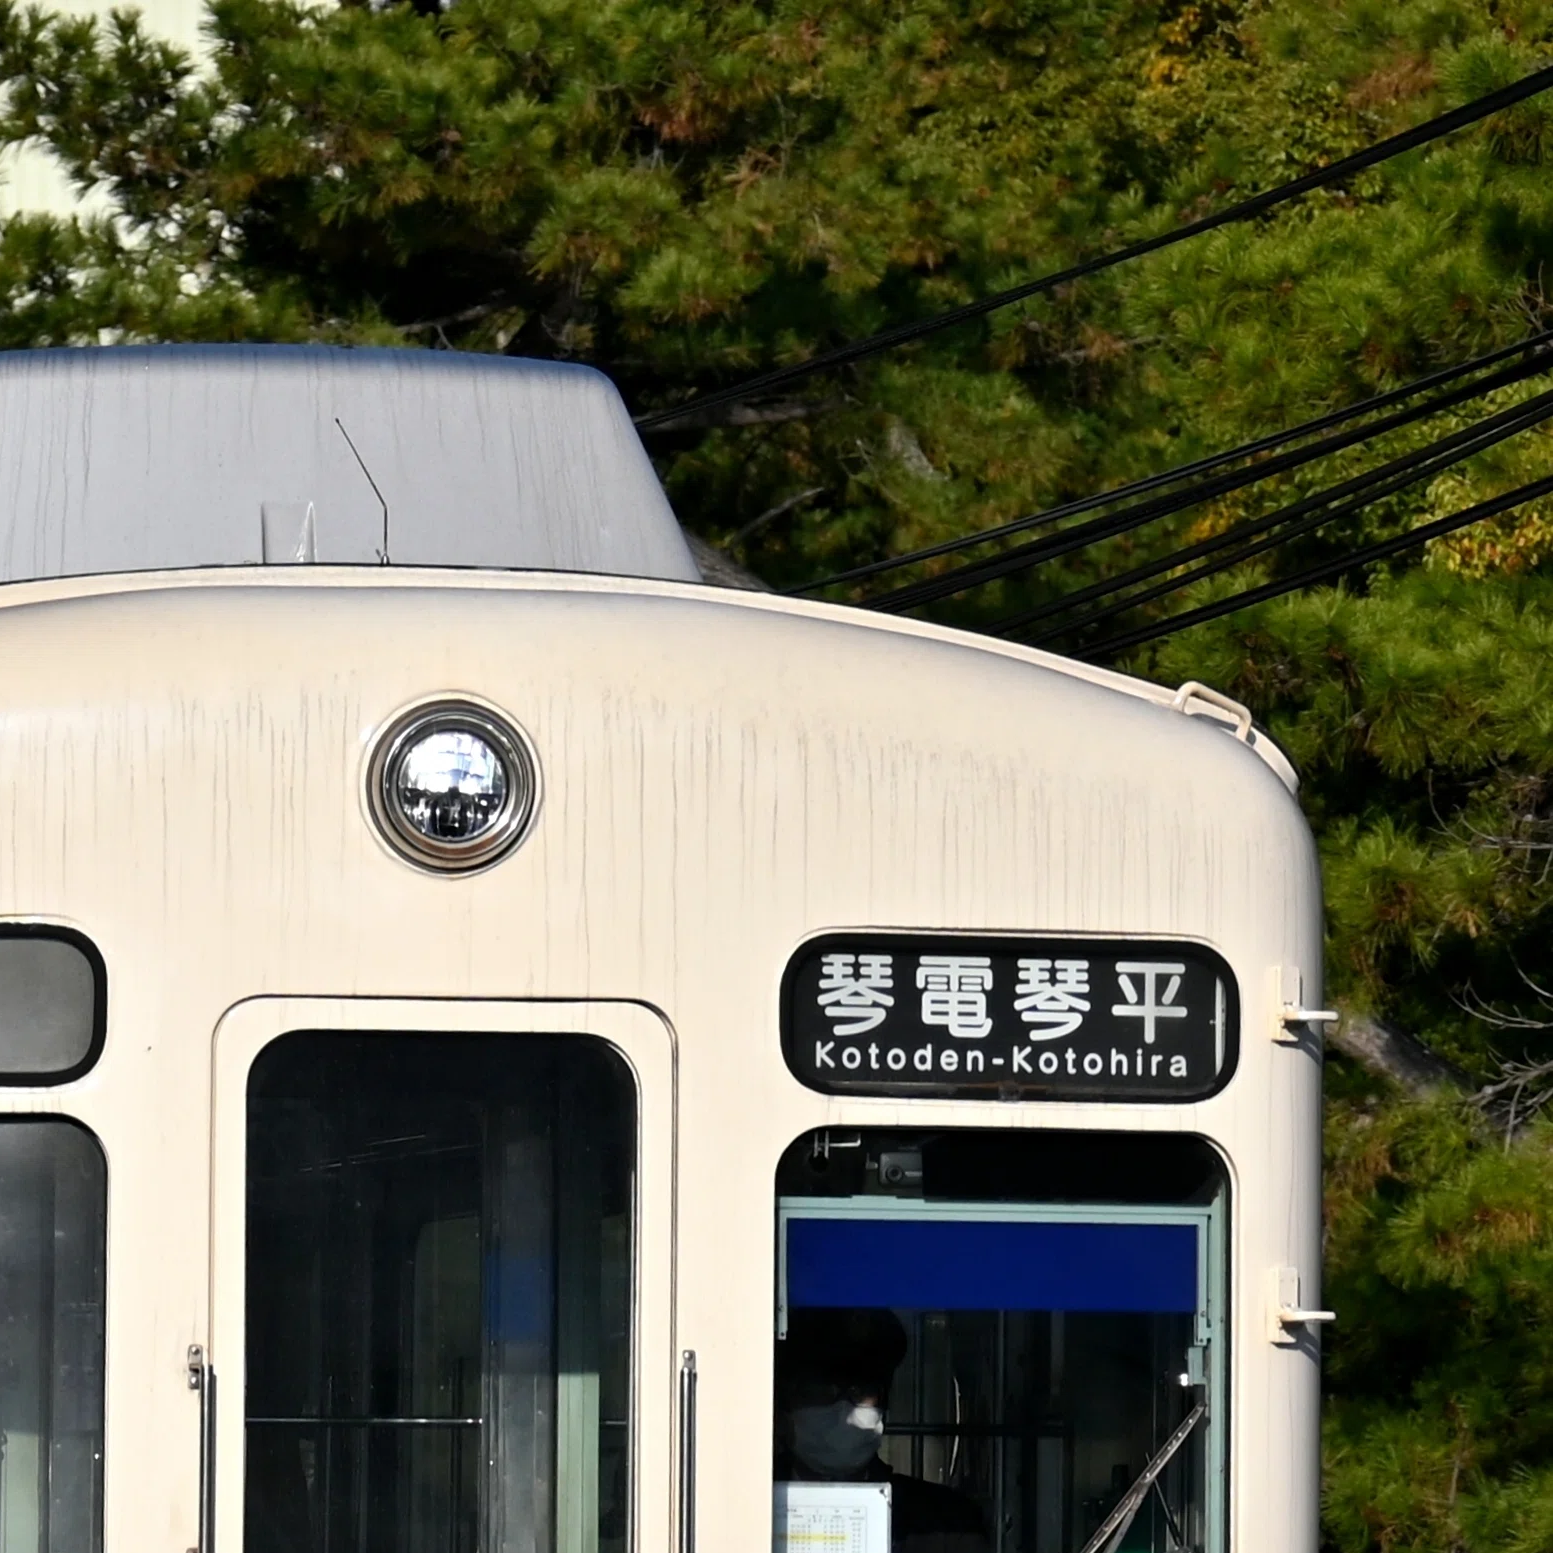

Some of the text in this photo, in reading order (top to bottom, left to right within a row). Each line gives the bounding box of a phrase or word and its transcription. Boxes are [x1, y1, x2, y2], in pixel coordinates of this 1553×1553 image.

[815, 953, 1188, 1044] 琴電琴平
[814, 1040, 1188, 1078] Kotoden-Kotohira
